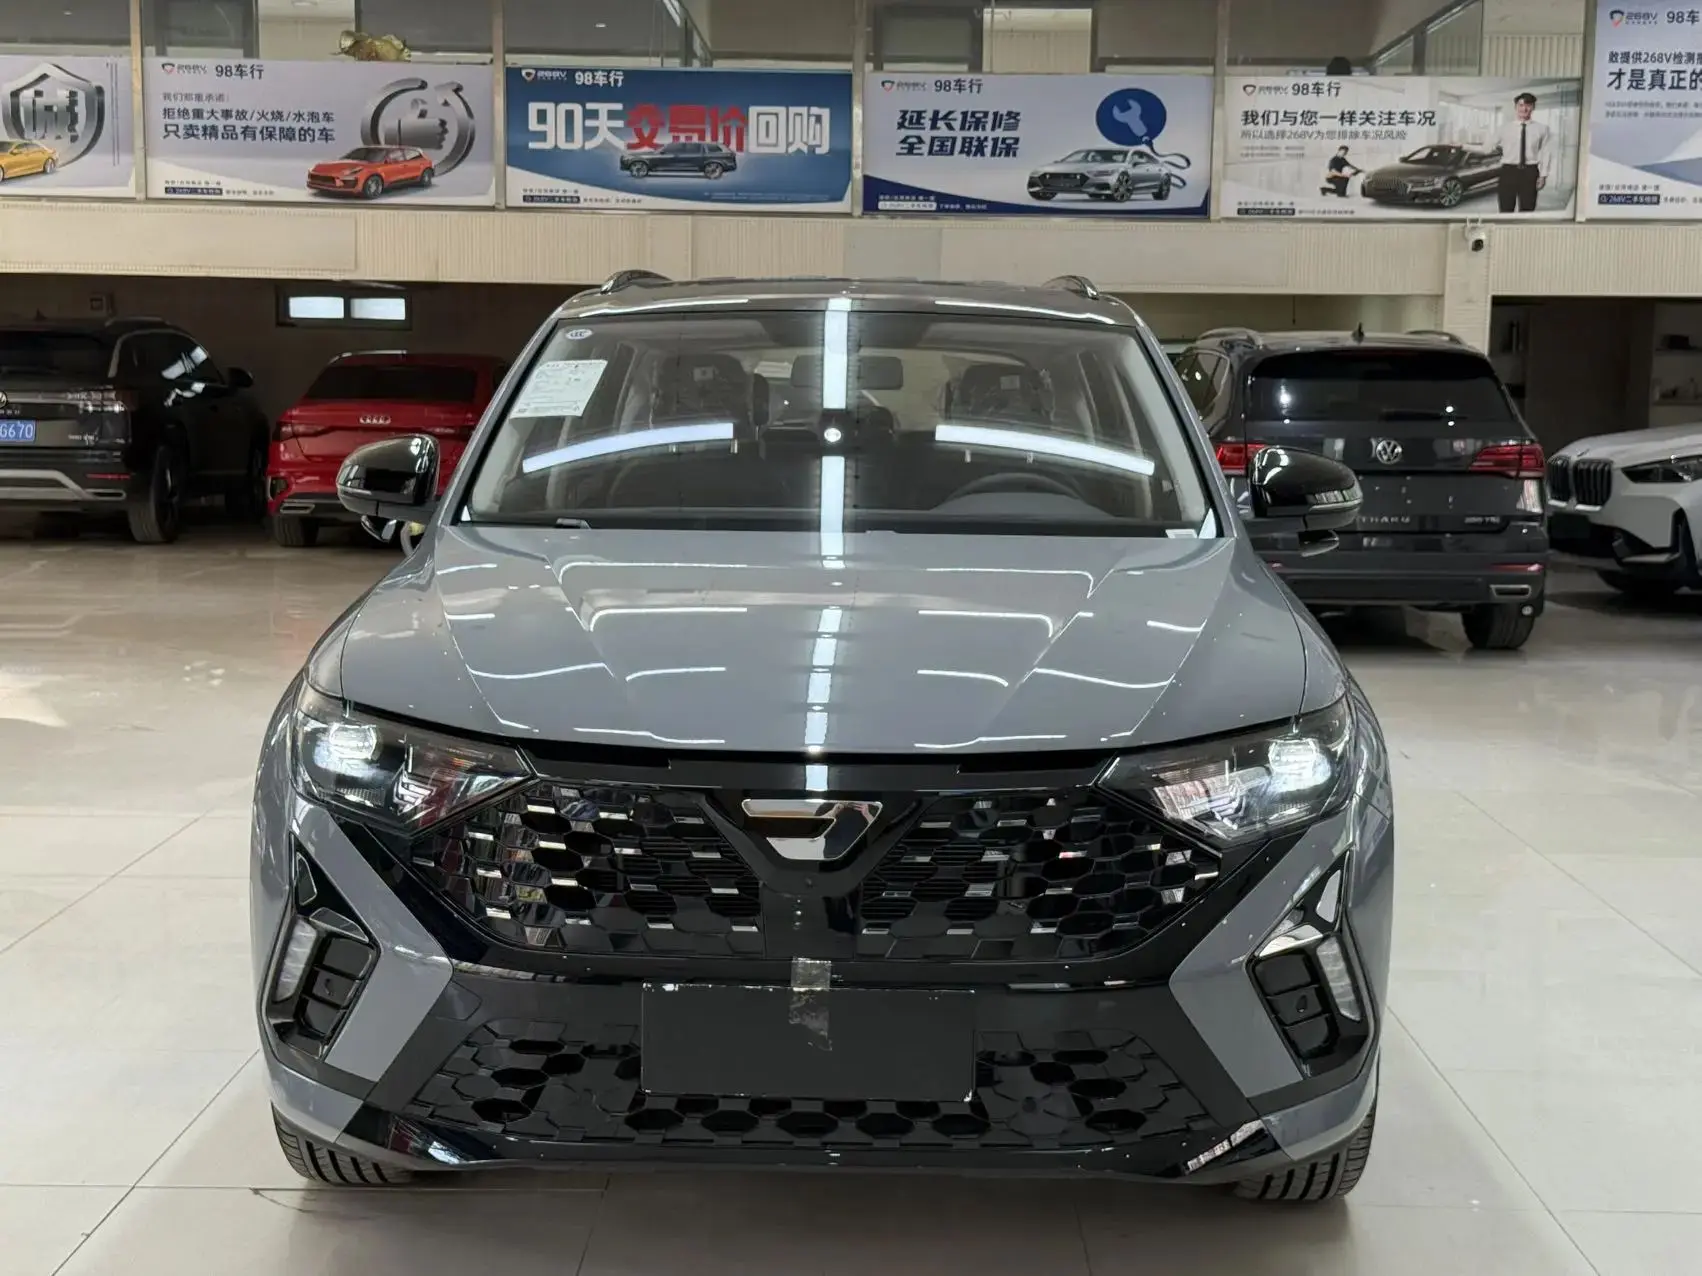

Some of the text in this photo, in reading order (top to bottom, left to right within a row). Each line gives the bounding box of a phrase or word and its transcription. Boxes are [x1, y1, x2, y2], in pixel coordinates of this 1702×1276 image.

[215, 63, 264, 80] 98车行
[574, 70, 624, 87] 98车行
[934, 78, 983, 94] 98车行
[1291, 81, 1341, 97] 98车行
[162, 107, 335, 124] 拒绝重大事故/火烧/水泡车
[896, 109, 1021, 132] 延长保修
[1241, 110, 1436, 127] 我们与您一样关注车况
[162, 124, 336, 142] 只卖精品有保障的车
[528, 102, 830, 154] 90天交易价回购
[896, 135, 1020, 158] 全国联保
